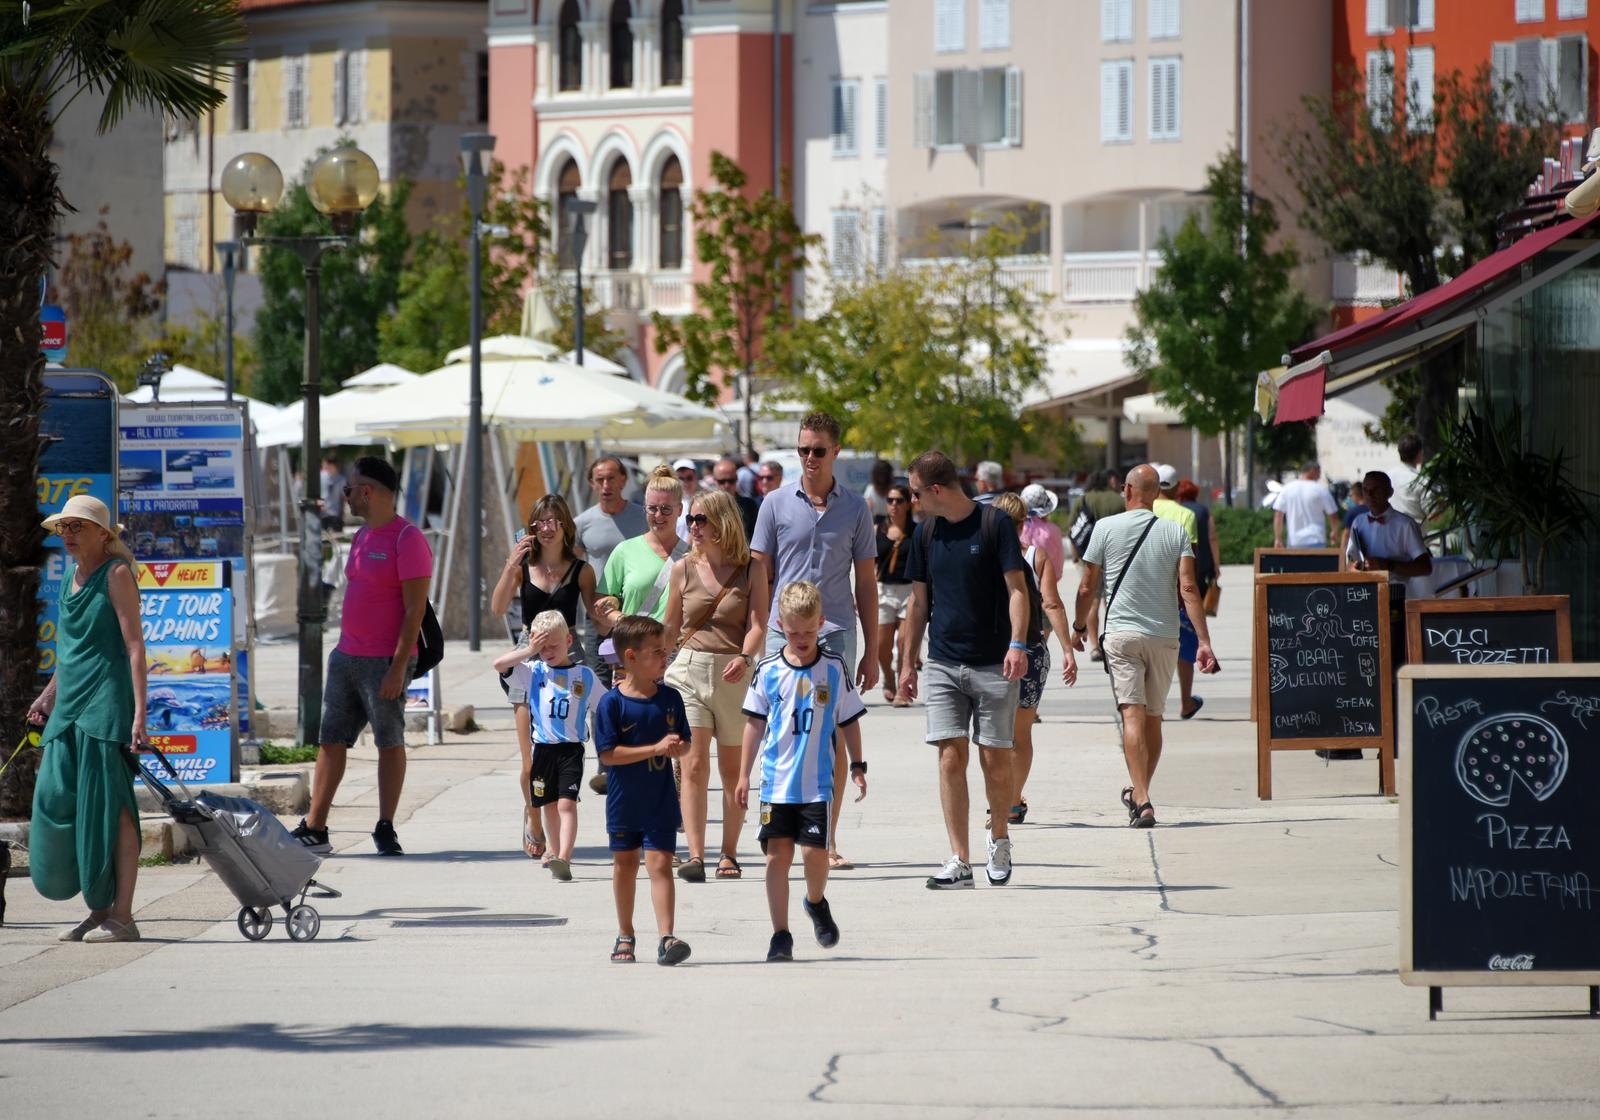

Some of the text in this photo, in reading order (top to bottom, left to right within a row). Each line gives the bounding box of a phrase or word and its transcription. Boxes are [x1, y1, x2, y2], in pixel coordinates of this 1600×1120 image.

[36, 477, 93, 504] ATE
[143, 501, 152, 511] &
[155, 570, 168, 578] TOUR
[177, 569, 208, 581] HEUTE
[177, 592, 222, 616] TOUR
[141, 617, 220, 642] OLPHINS
[1352, 619, 1374, 632] EIS
[1271, 636, 1302, 651] PIZZA
[1426, 628, 1488, 647] DOLCI
[1296, 648, 1344, 670] OBALA
[1451, 647, 1549, 664] POZZETTI
[1288, 671, 1348, 688] WELCOME
[549, 696, 569, 720] 10
[1336, 698, 1375, 708] STEAK
[1416, 696, 1484, 728] PASTA
[791, 708, 814, 735] 10
[1341, 716, 1375, 733] PASTA
[174, 757, 217, 769] WILD
[1477, 813, 1572, 850] PIZZA
